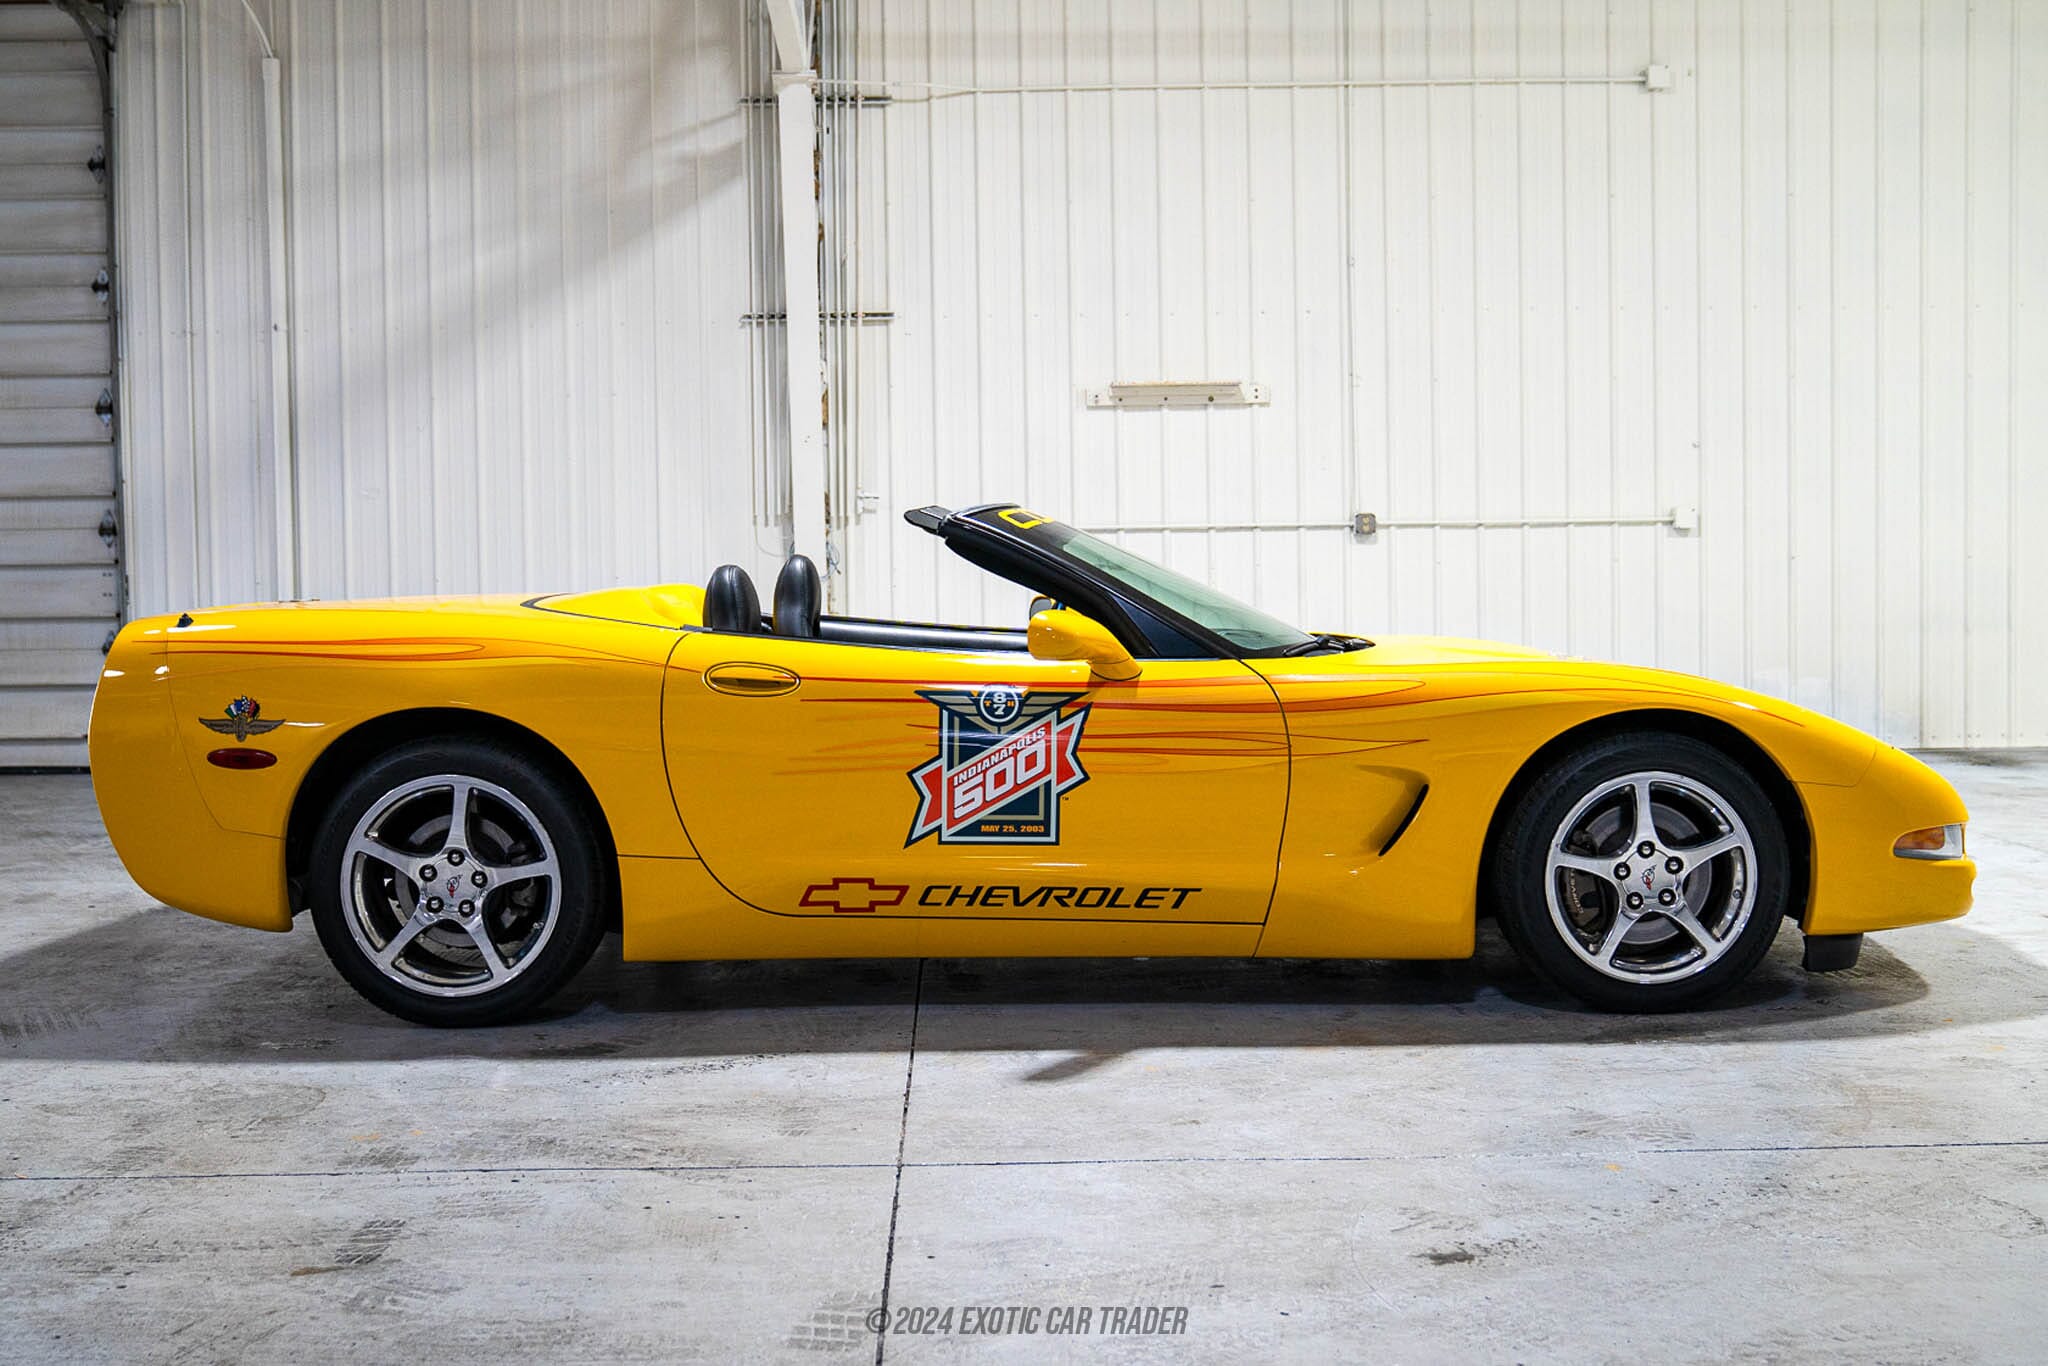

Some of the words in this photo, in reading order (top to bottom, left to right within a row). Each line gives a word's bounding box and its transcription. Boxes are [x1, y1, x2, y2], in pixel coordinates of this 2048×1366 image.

[954, 727, 1046, 786] INDIANAPOLIS
[954, 740, 1046, 819] 500
[980, 825, 1000, 833] MAY
[1020, 825, 1045, 833] 2003
[918, 885, 1203, 910] CHEVROLET
